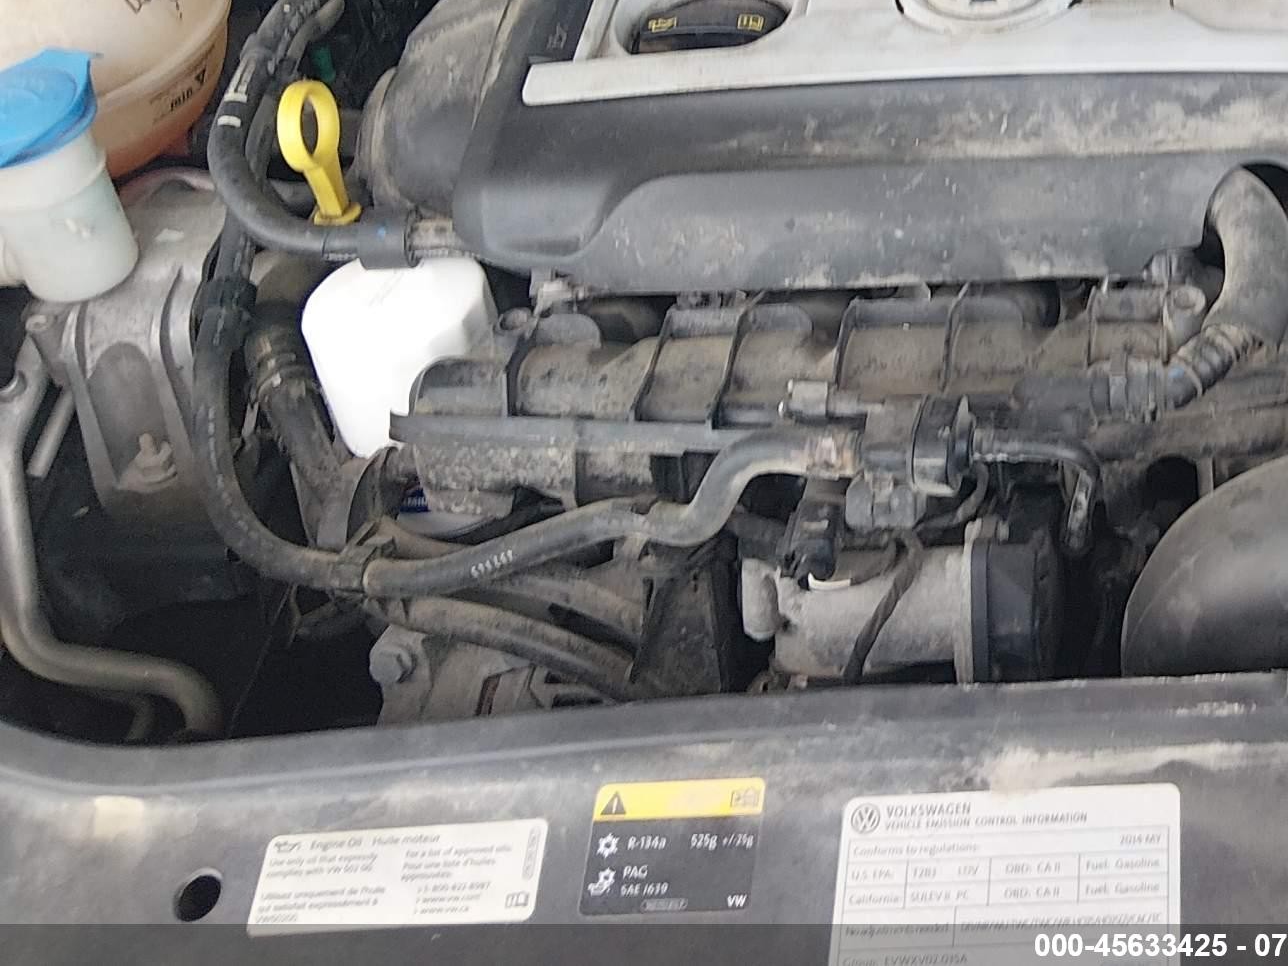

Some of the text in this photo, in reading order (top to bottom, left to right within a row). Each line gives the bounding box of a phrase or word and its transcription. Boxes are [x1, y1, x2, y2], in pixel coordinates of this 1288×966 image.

[886, 802, 971, 818] VOLKSWAGEN
[925, 816, 971, 829] EMISSION
[974, 814, 1018, 827] CONTROL
[1021, 811, 1088, 825] INFORMATION
[622, 864, 648, 879] PAG
[727, 893, 748, 908] VW
